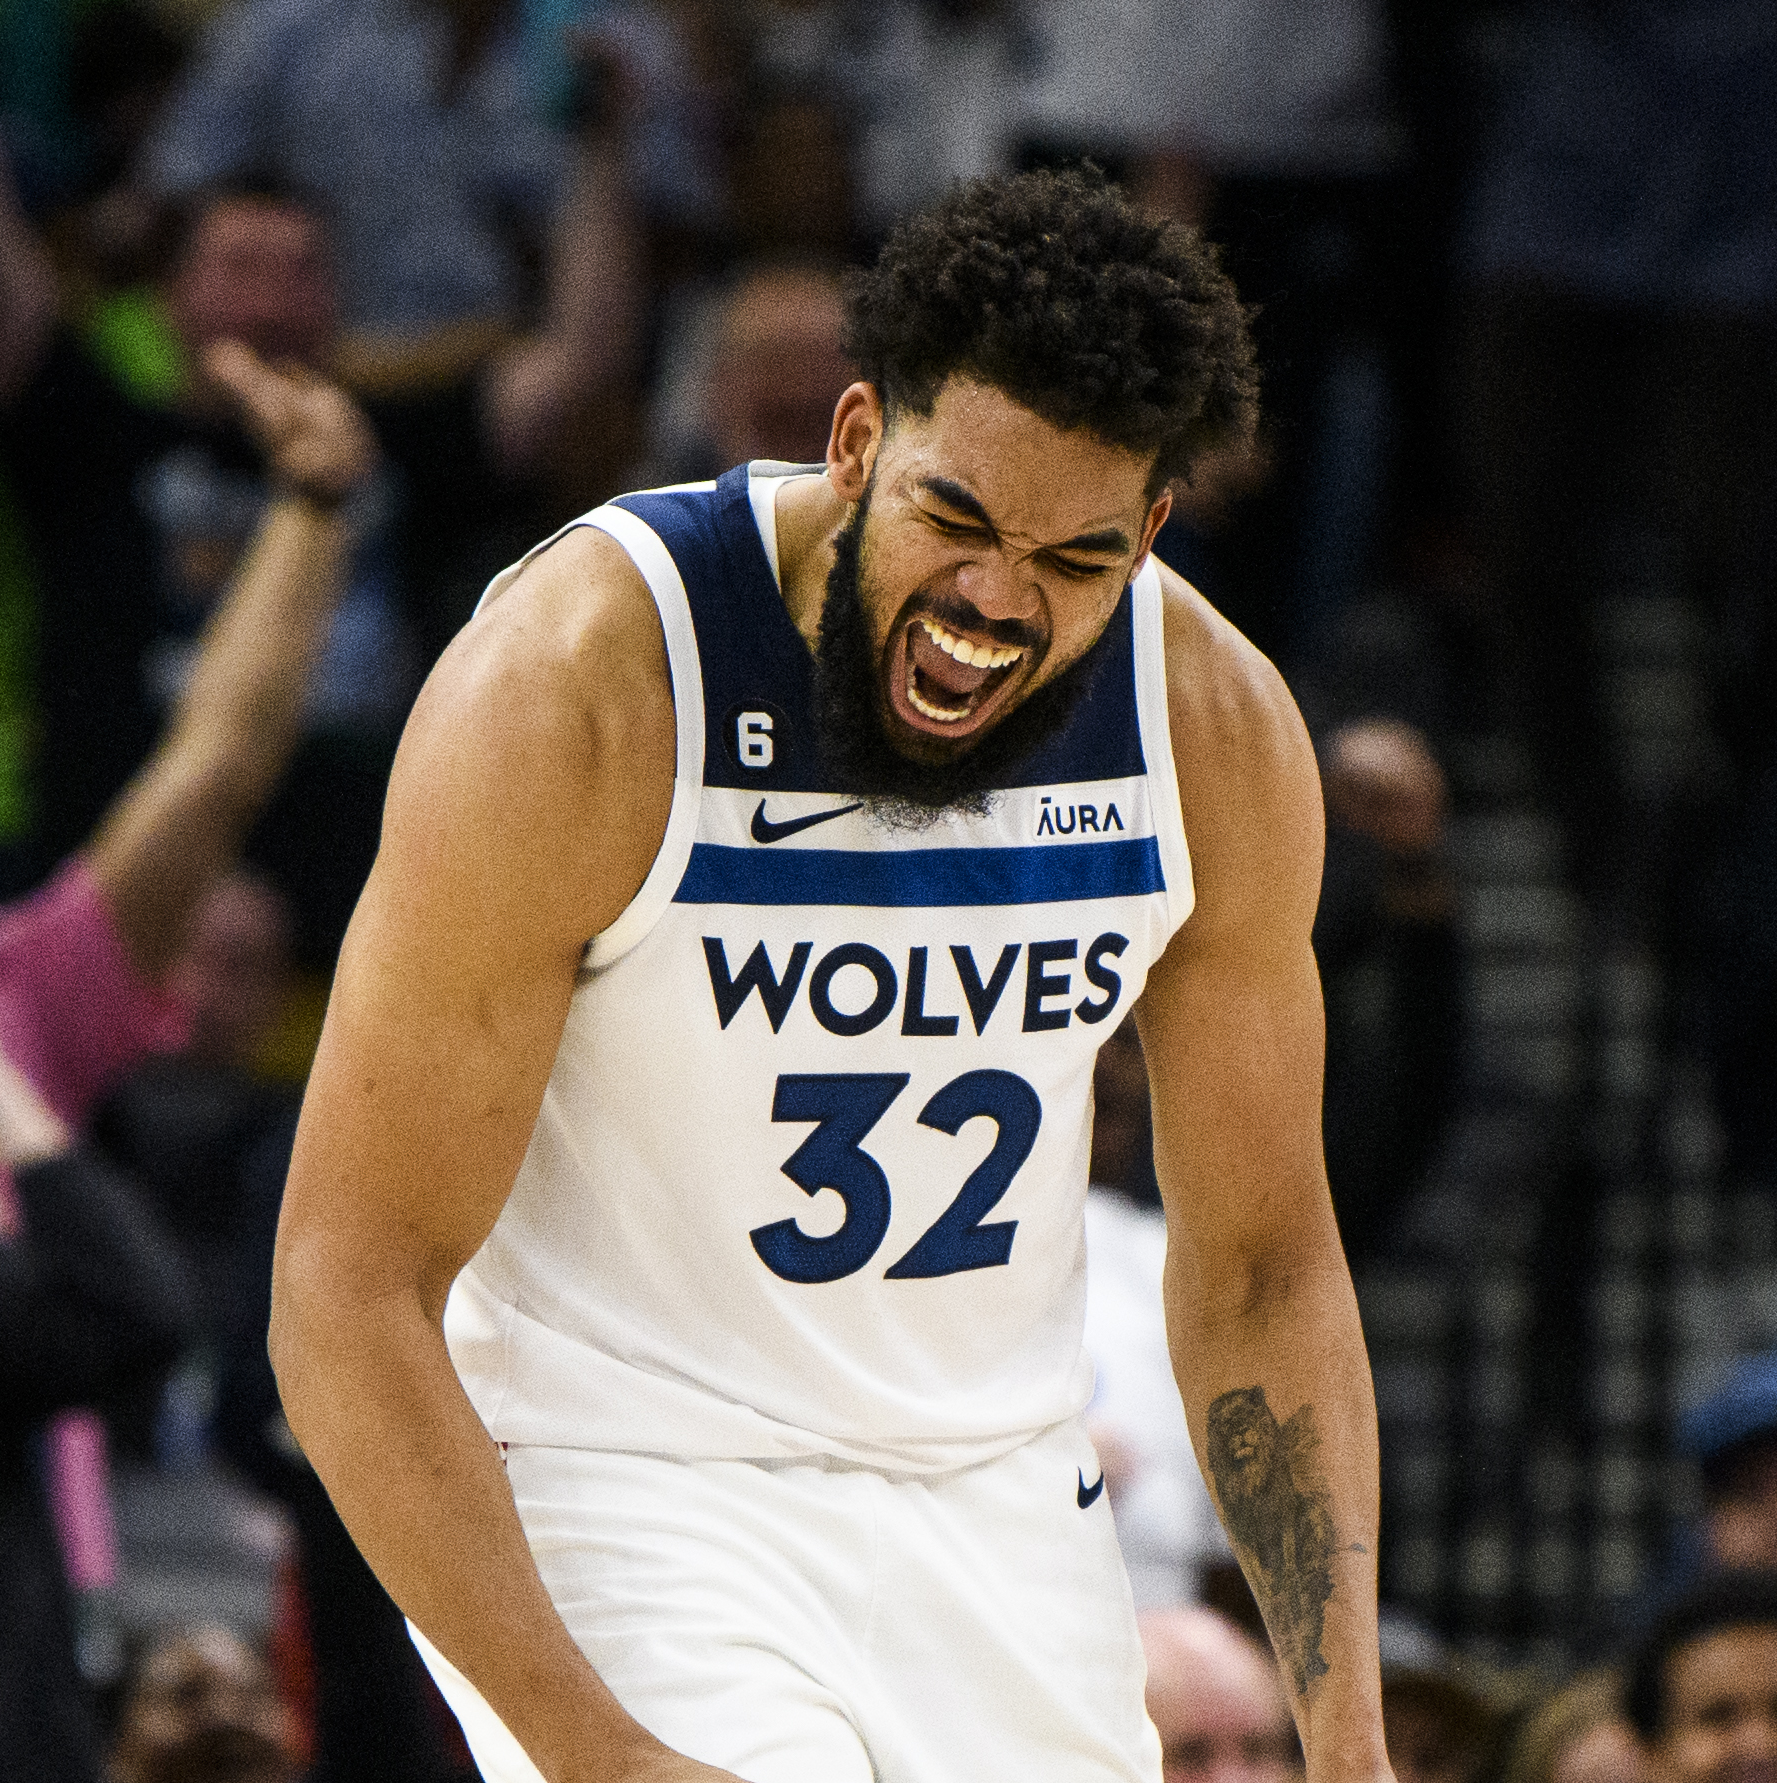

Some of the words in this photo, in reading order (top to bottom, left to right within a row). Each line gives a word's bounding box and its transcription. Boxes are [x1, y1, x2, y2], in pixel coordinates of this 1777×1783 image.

[737, 711, 774, 767] 6
[702, 932, 1130, 1037] WOLVES
[749, 1069, 1043, 1284] 32
